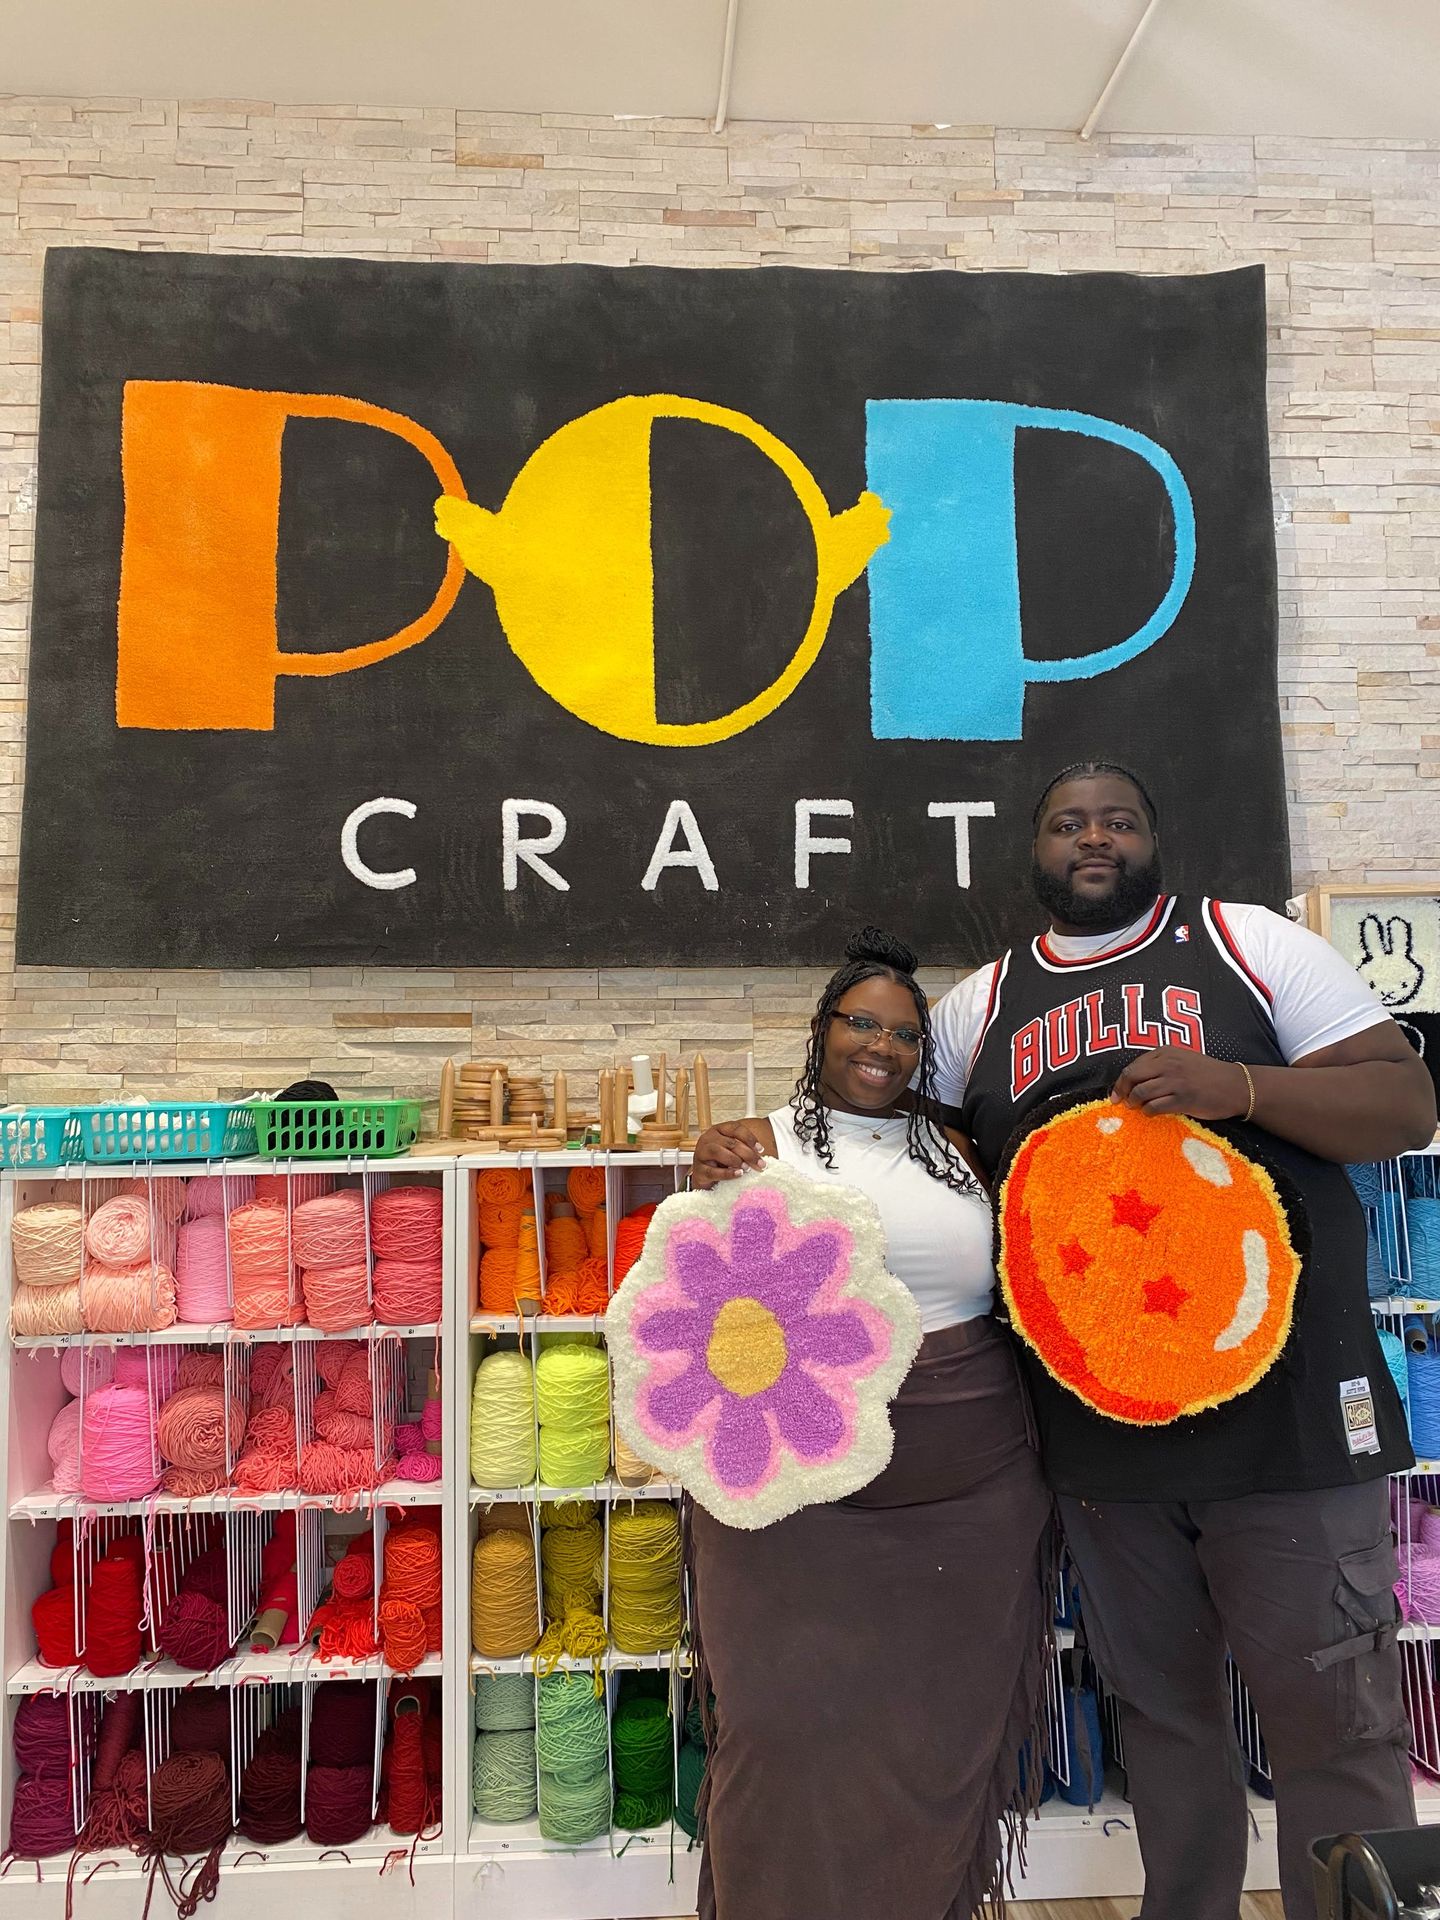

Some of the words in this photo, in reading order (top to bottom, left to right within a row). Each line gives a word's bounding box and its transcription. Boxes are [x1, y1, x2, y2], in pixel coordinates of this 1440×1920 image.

[114, 380, 1197, 748] POP
[339, 796, 997, 893] CRAFT
[1010, 983, 1206, 1104] BULLS
[84, 1679, 95, 1688] 35
